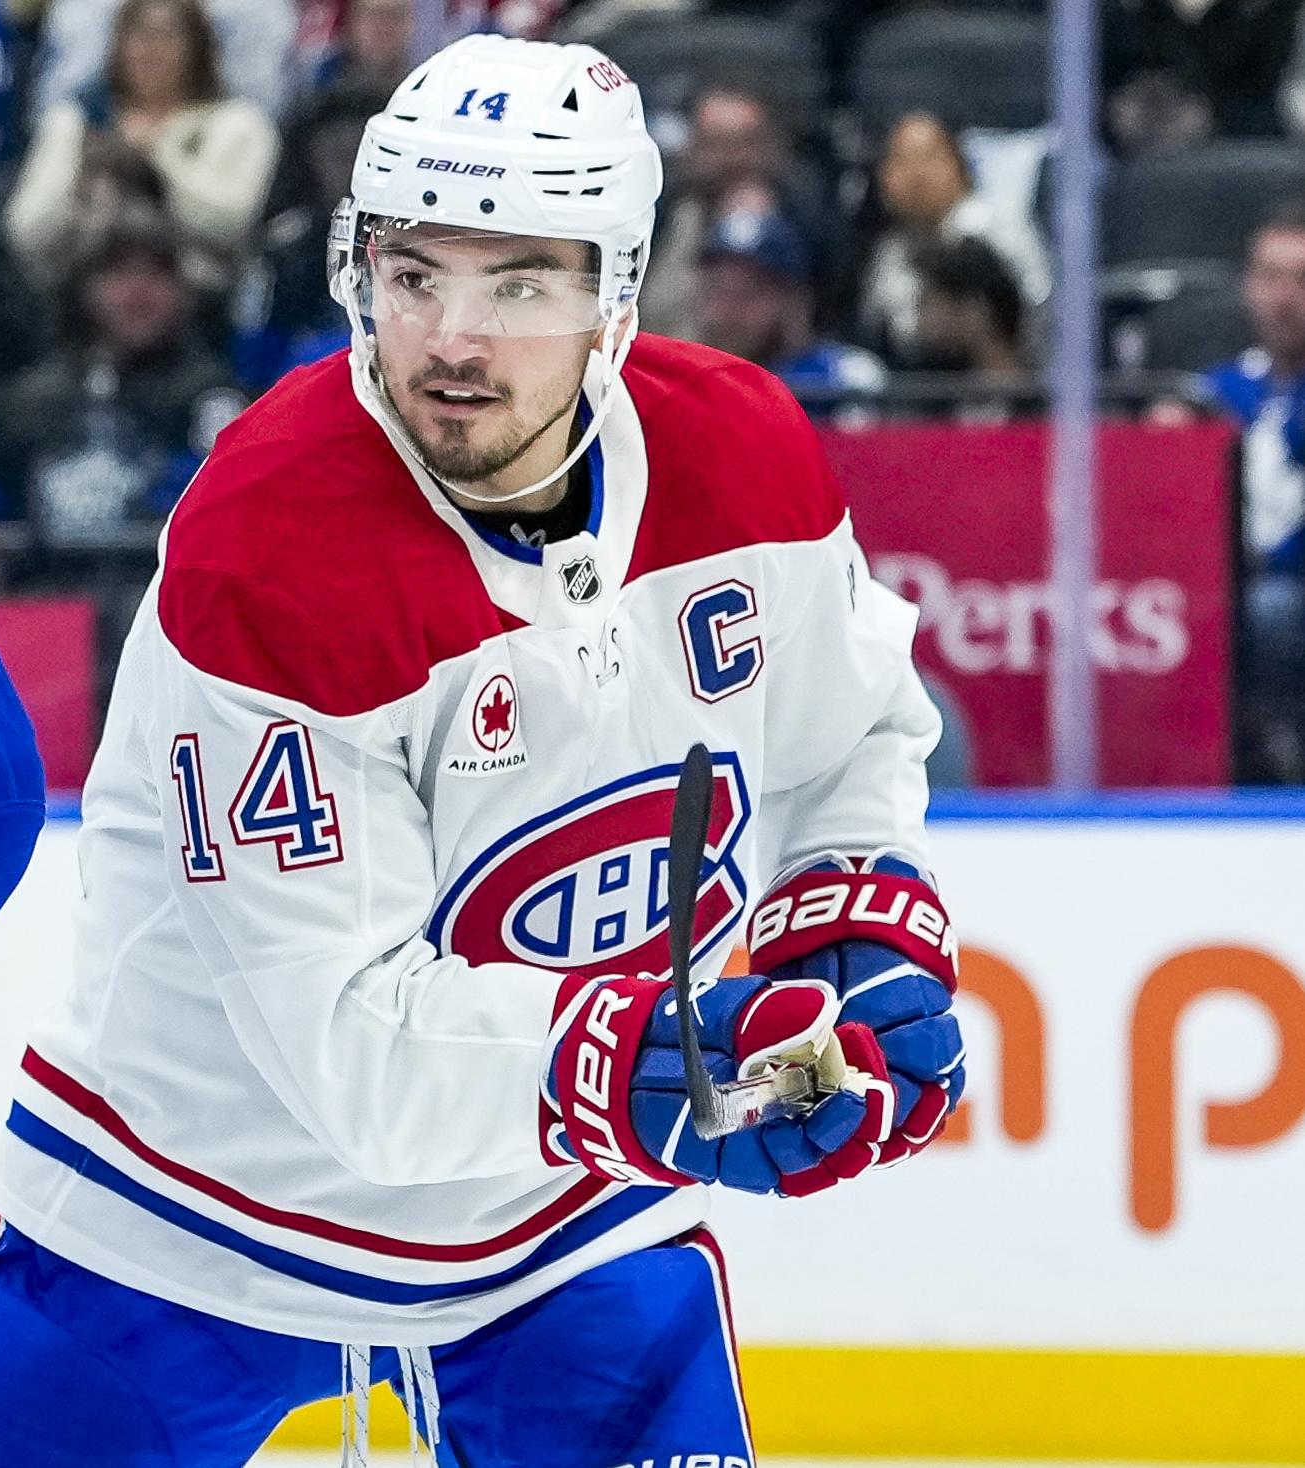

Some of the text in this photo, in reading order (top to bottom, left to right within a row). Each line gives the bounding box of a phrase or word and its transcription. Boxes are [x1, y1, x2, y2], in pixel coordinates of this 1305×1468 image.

[452, 88, 510, 121] 14
[416, 157, 507, 180] BAUER
[678, 579, 764, 704] C
[448, 752, 526, 772] AIR CANADA
[170, 720, 344, 883] 14
